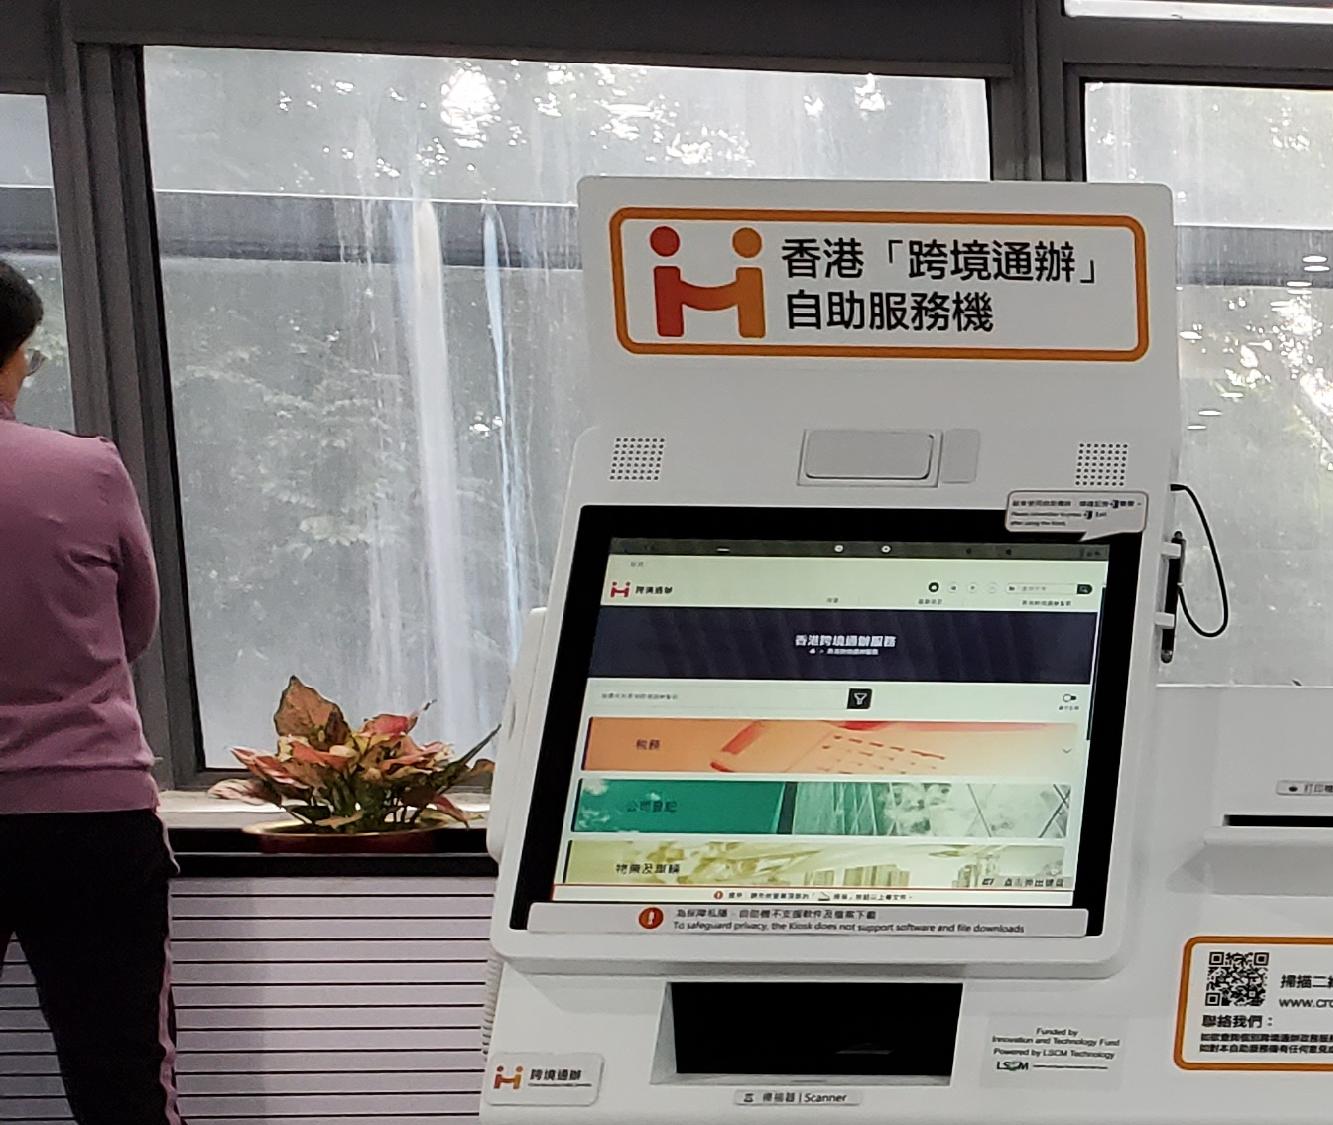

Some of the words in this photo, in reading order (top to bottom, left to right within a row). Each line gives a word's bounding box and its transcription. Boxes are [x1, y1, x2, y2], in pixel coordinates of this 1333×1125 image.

[781, 236, 1097, 286] 香港「跨境通辦」
[786, 289, 994, 333] 自助服務機
[673, 921, 686, 931] To
[687, 921, 733, 933] safeguard
[771, 922, 788, 932] the
[813, 922, 838, 932] does
[838, 923, 855, 932] not
[858, 923, 895, 934] support
[896, 923, 937, 933] software
[937, 923, 955, 933] and
[973, 924, 1025, 934] downloads
[1201, 1014, 1274, 1029] 聯絡我們：
[1036, 1027, 1067, 1036] Funded
[1067, 1028, 1079, 1038] by
[803, 1092, 848, 1103] Scanner
